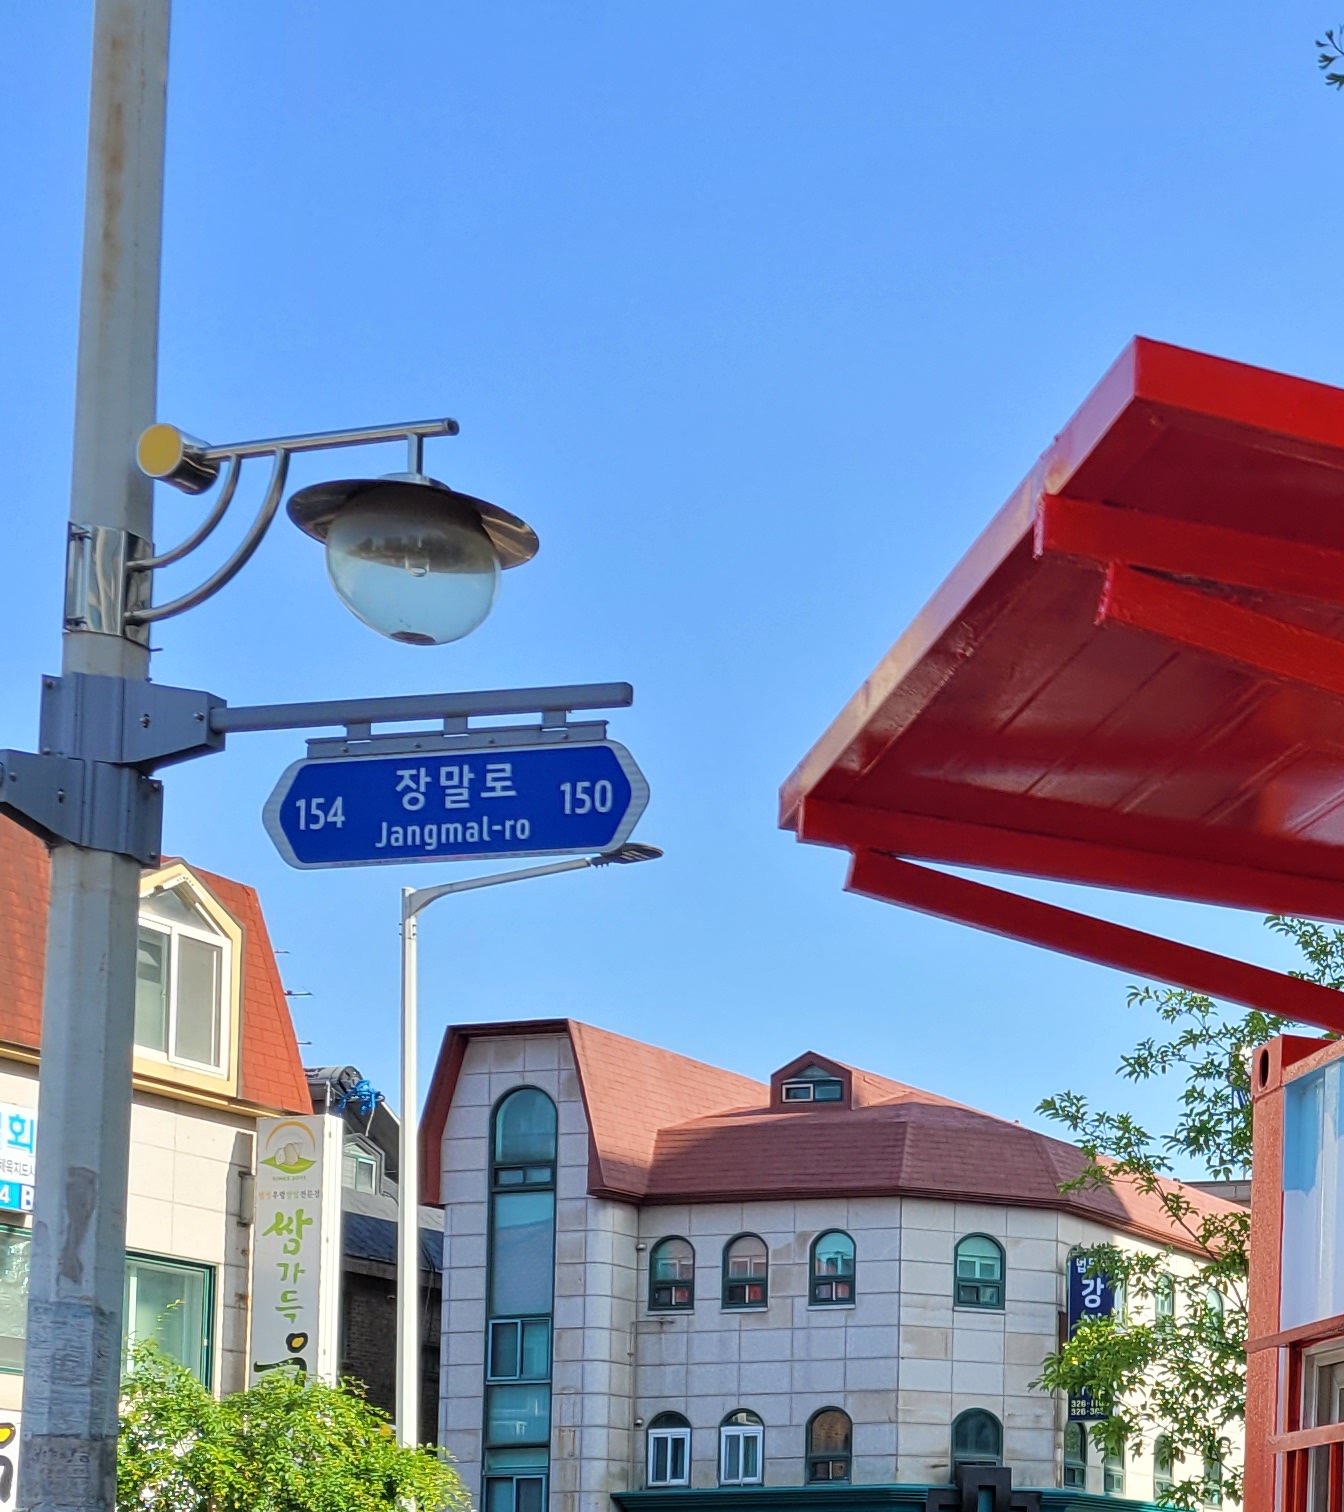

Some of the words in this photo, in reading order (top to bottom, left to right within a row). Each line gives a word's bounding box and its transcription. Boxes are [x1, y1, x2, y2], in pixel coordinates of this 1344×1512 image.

[396, 763, 518, 811] 장말로
[560, 780, 613, 815] 150
[295, 796, 345, 830] 154
[375, 815, 531, 850] Jangmal-ro
